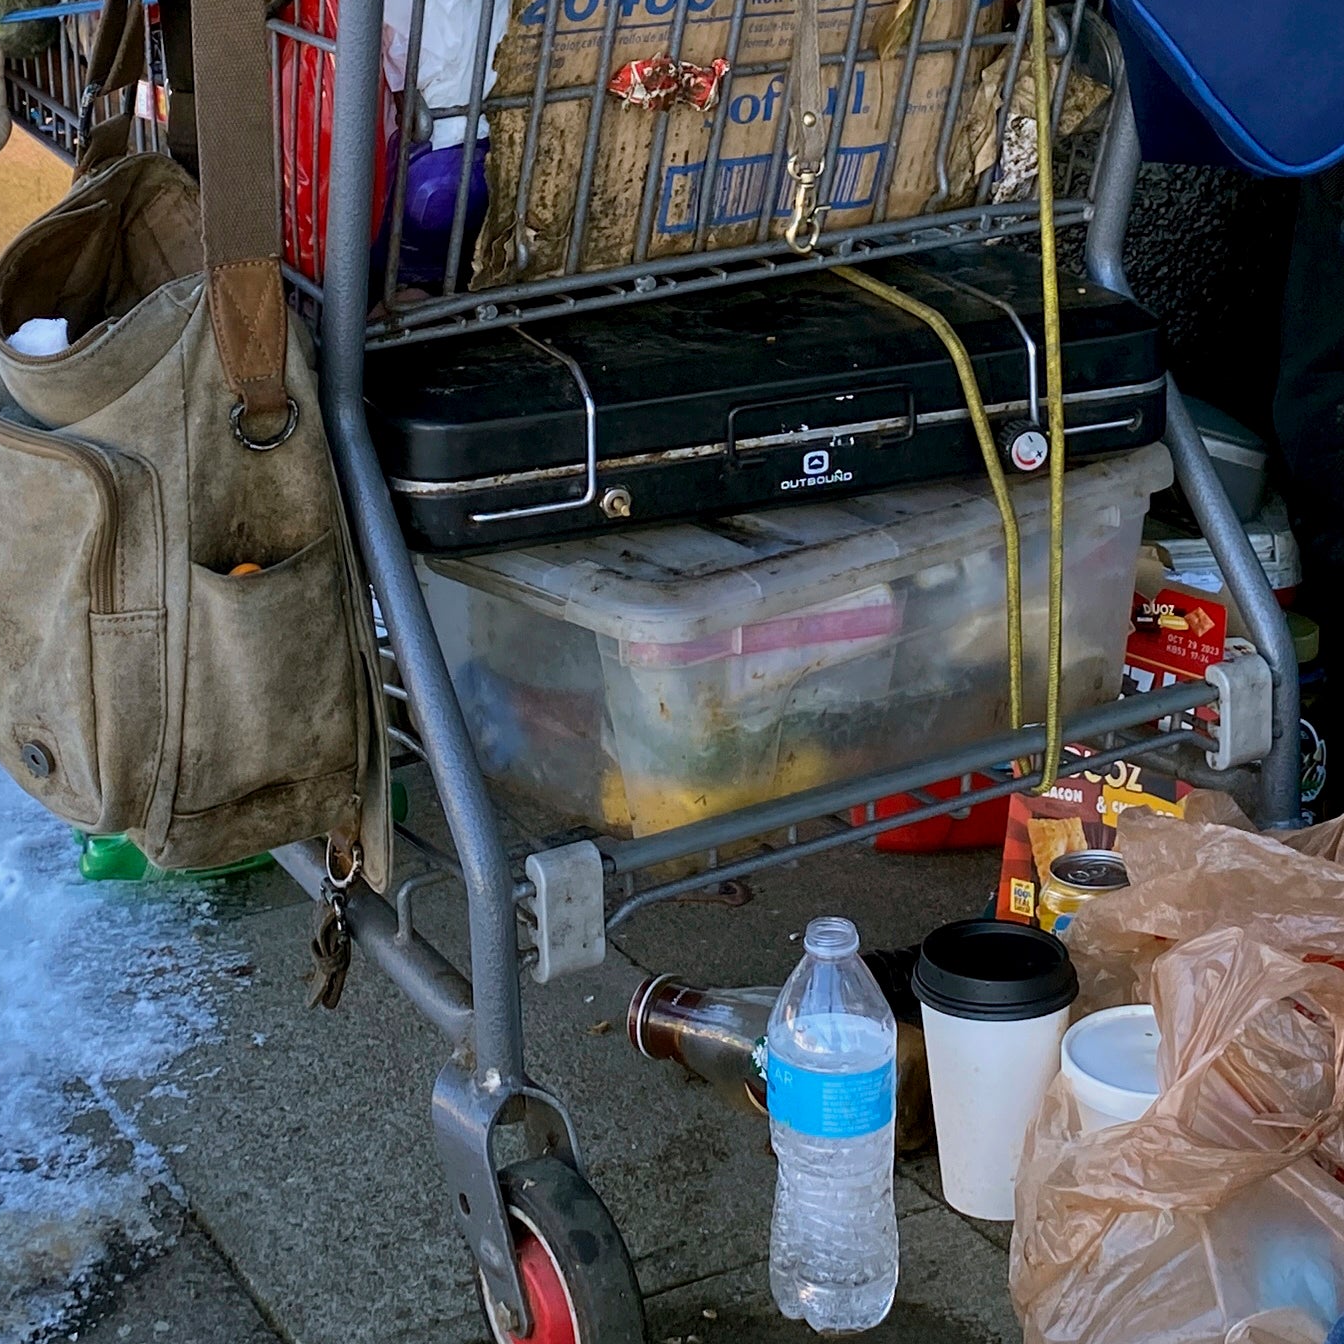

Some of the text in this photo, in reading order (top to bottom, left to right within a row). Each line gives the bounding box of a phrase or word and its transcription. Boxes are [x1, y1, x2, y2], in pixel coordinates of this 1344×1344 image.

[780, 471, 853, 490] OUTBOUND
[1143, 603, 1175, 616] DUOZ
[1167, 634, 1184, 645] OCT
[1042, 786, 1083, 804] ACON
